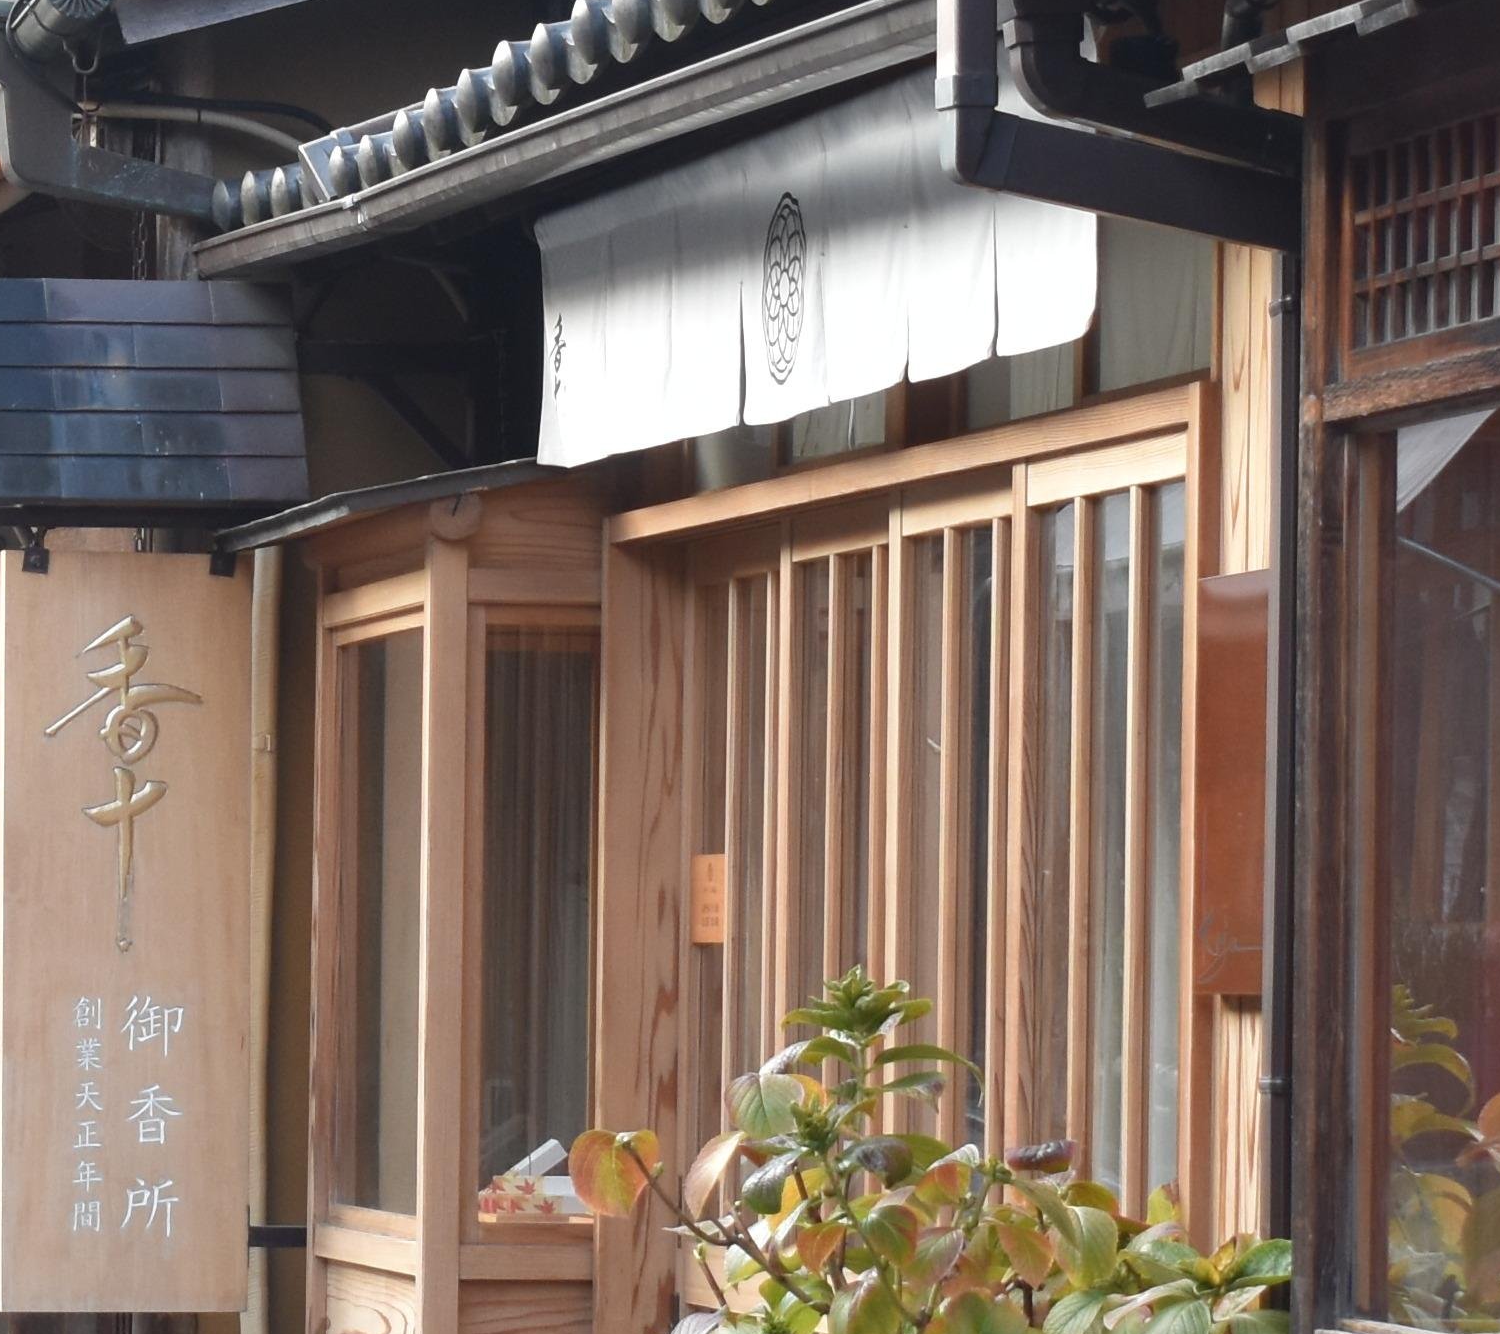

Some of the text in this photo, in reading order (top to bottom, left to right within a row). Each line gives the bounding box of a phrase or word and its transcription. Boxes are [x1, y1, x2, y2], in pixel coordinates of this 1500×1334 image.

[43, 614, 203, 953] 香十
[72, 996, 103, 1233] 創業天正年間
[120, 995, 184, 1238] 御香所
